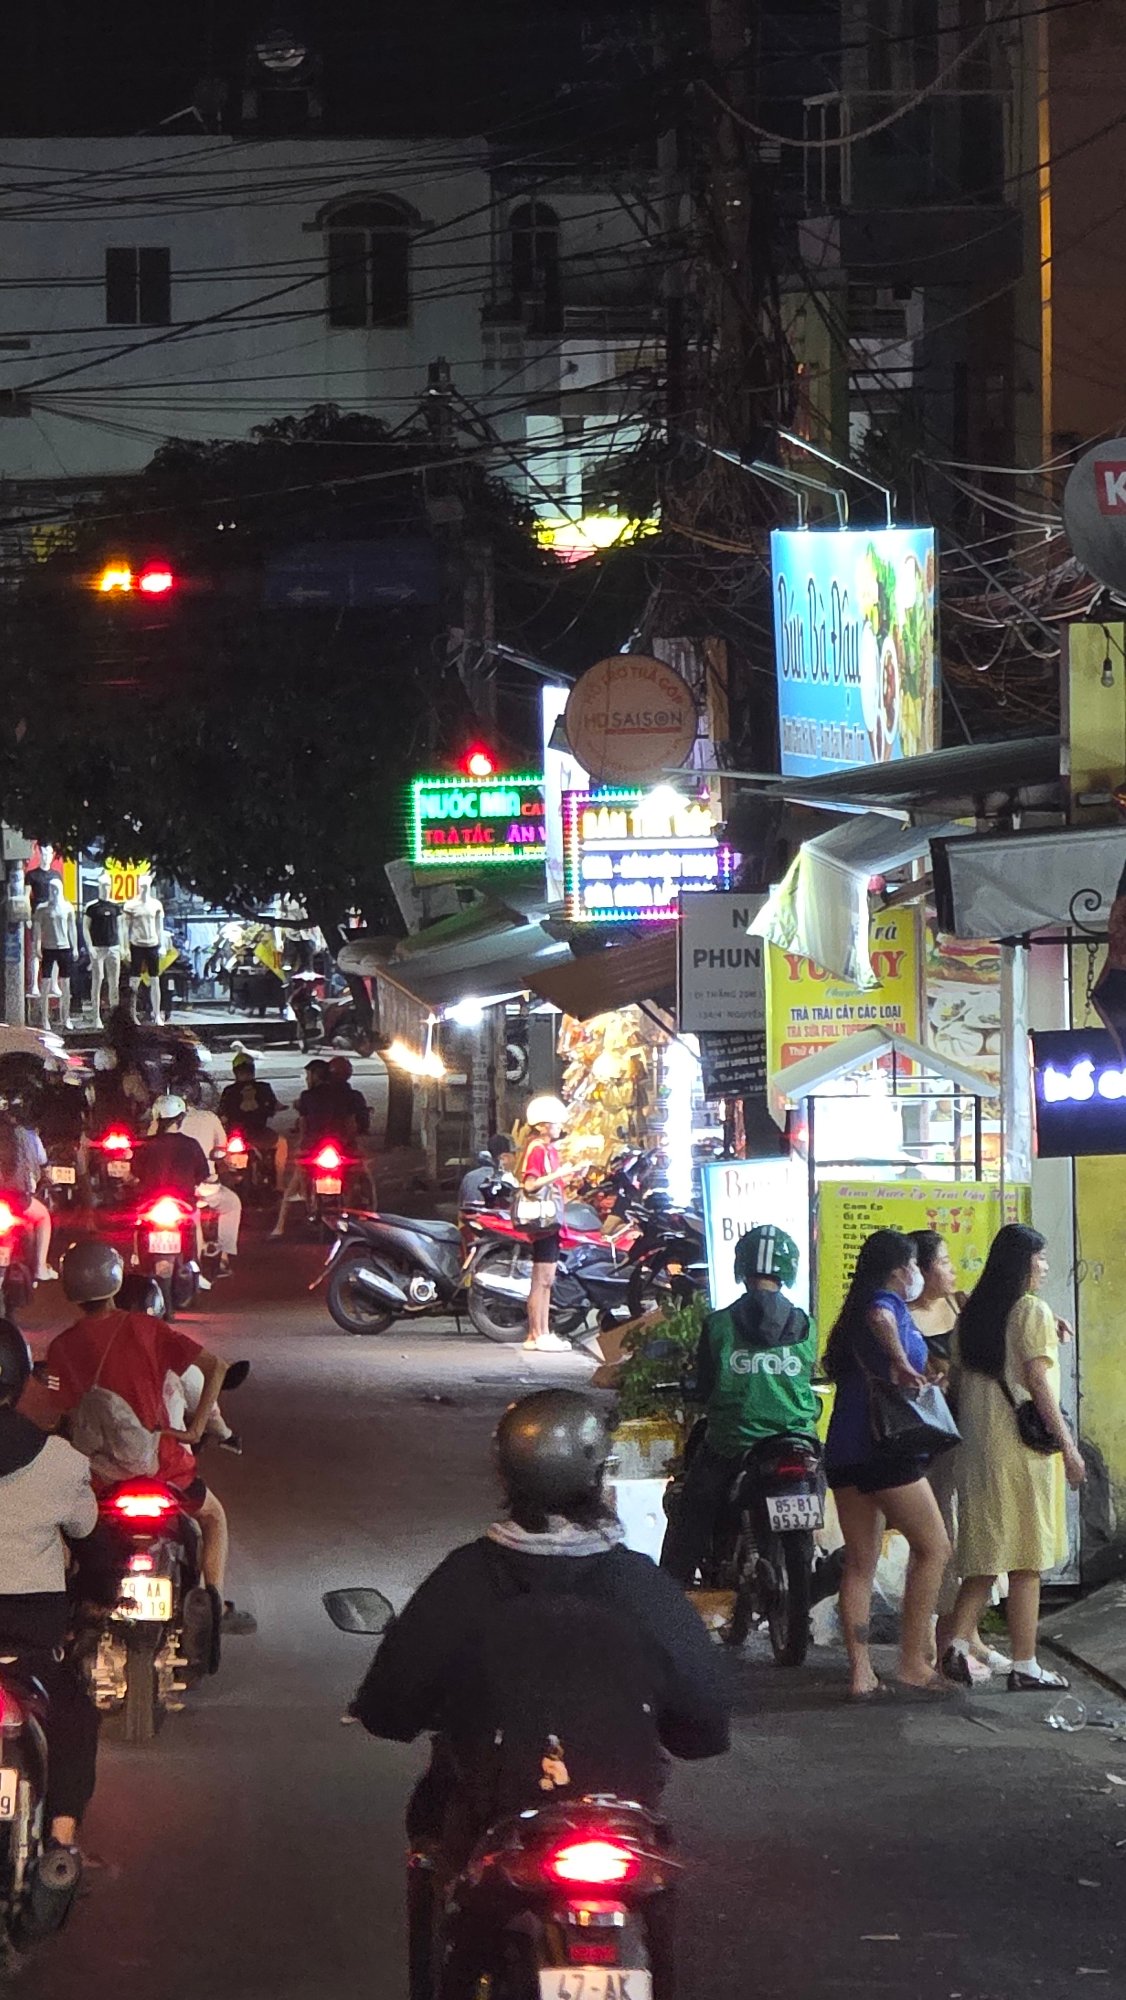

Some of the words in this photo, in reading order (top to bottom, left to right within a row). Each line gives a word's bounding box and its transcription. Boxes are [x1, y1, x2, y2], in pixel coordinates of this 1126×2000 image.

[871, 917, 898, 941] rà
[790, 1006, 809, 1021] TRÀ
[812, 1005, 833, 1021] TRÁI
[836, 1003, 856, 1019] CÂY
[857, 1003, 877, 1019] CÁC
[730, 1346, 803, 1377] Grab
